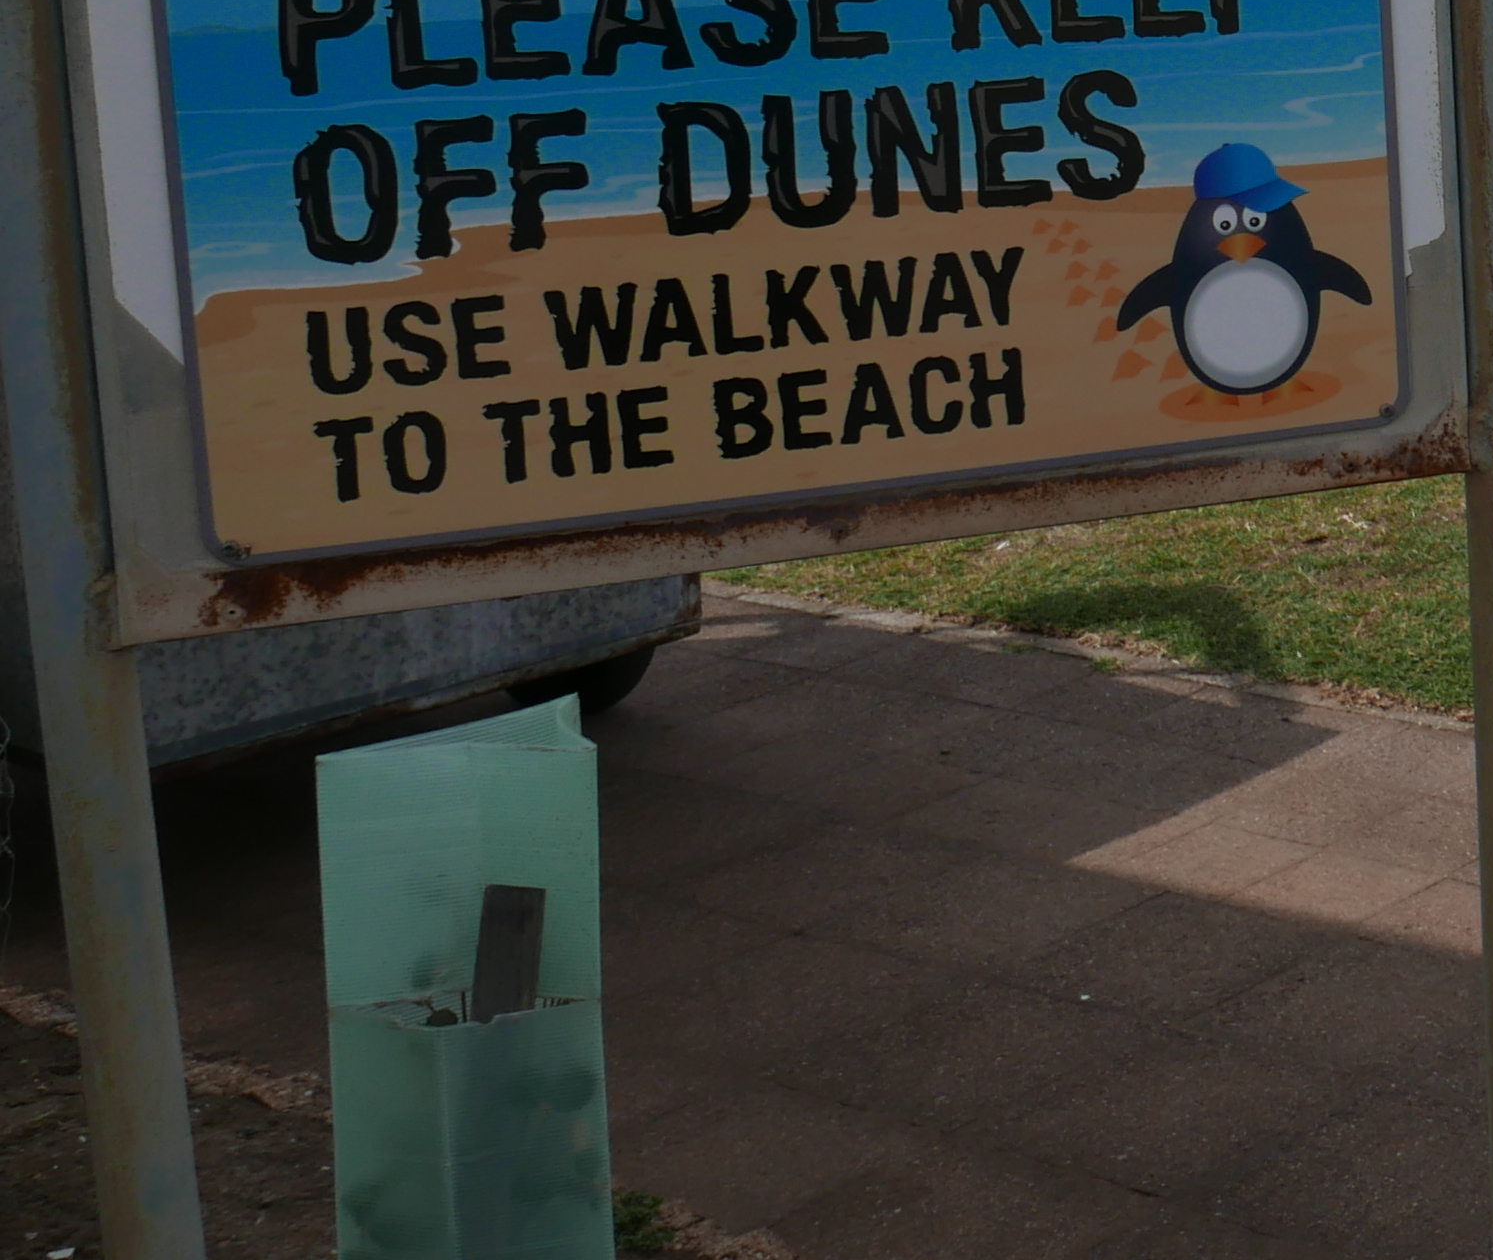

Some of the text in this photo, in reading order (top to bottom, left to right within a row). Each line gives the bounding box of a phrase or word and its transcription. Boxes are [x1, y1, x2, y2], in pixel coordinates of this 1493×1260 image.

[293, 69, 1146, 266] OFF DUNES
[305, 247, 1025, 396] USE WALKWAY
[312, 347, 1026, 504] TO THE BEACH
